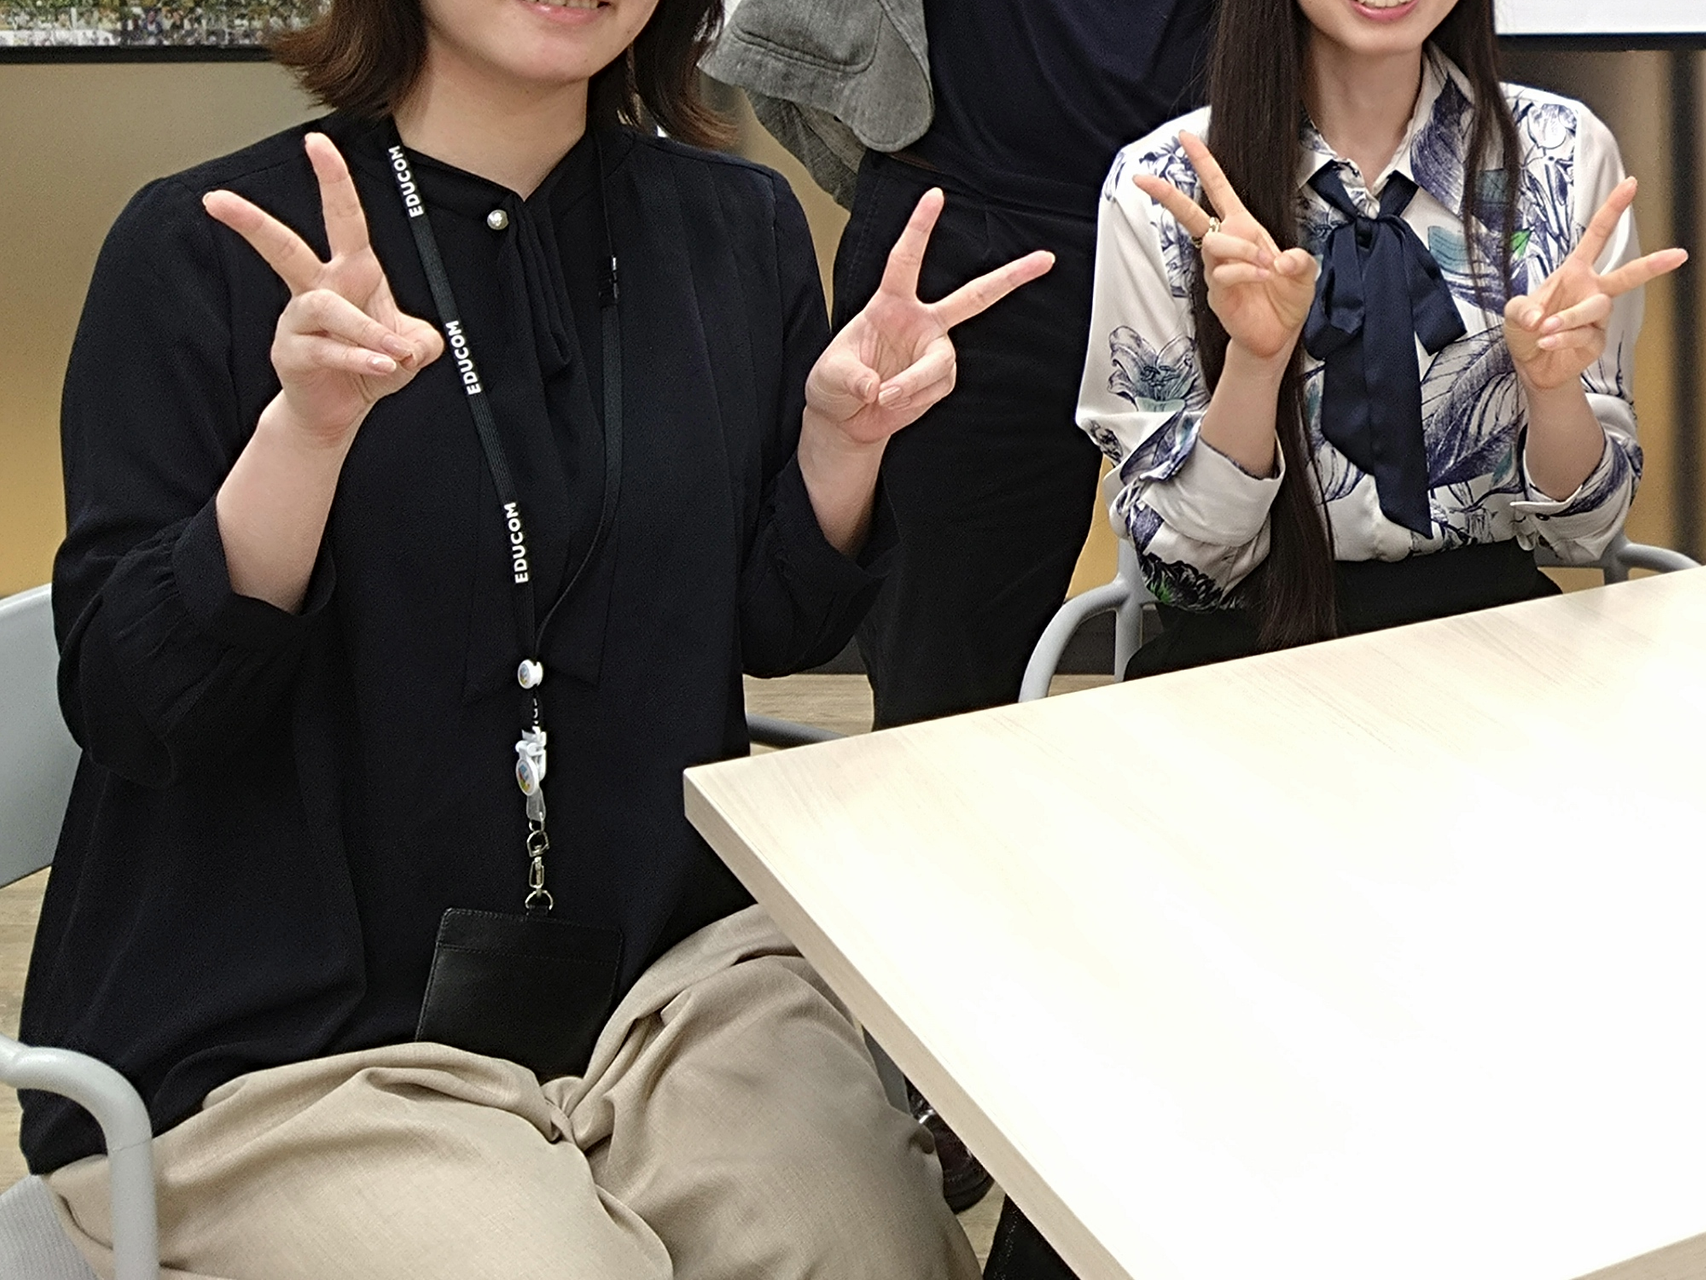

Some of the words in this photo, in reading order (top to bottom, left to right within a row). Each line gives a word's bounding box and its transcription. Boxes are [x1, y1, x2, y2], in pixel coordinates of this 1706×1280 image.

[388, 145, 424, 218] EDUCOM
[445, 320, 482, 395] EDUCOM
[503, 502, 529, 584] EDUCOM
